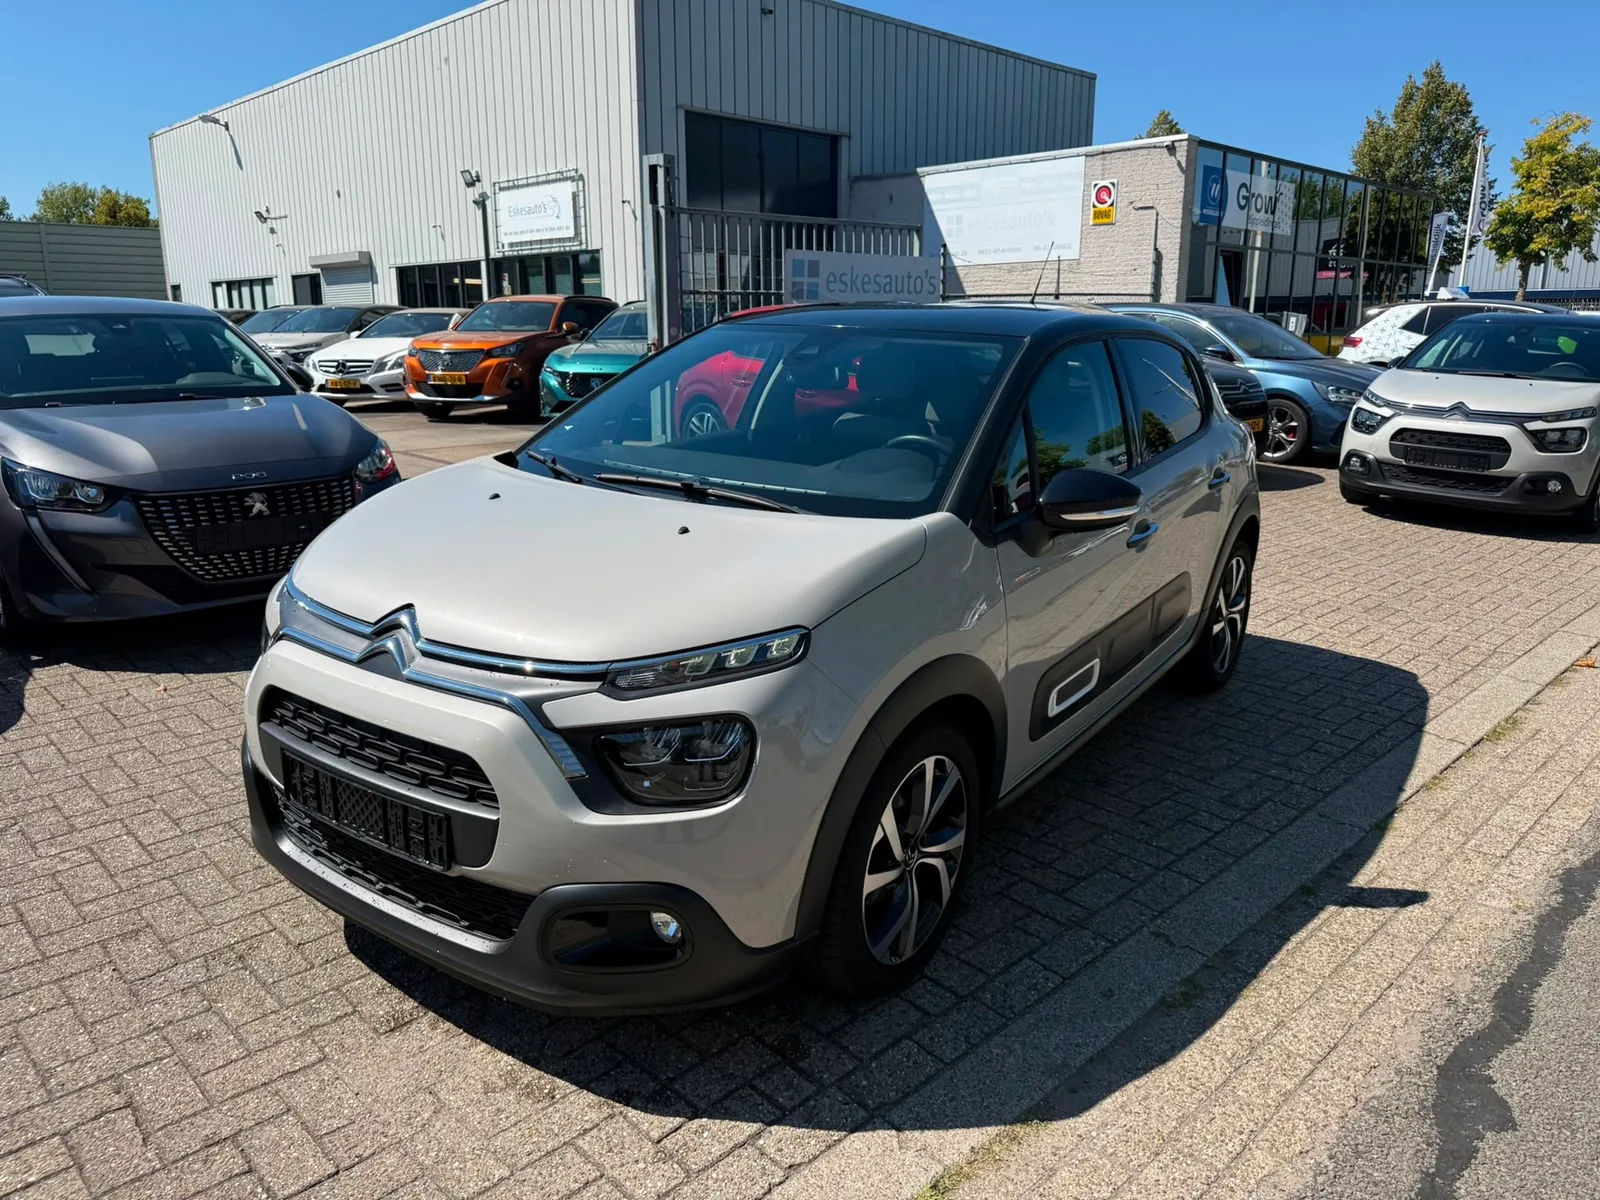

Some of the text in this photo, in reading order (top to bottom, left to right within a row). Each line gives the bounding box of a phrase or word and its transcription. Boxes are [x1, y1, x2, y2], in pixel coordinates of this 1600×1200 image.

[508, 201, 548, 218] Eskesauto's
[1236, 181, 1277, 216] Grow
[826, 265, 937, 296] eskesauto's
